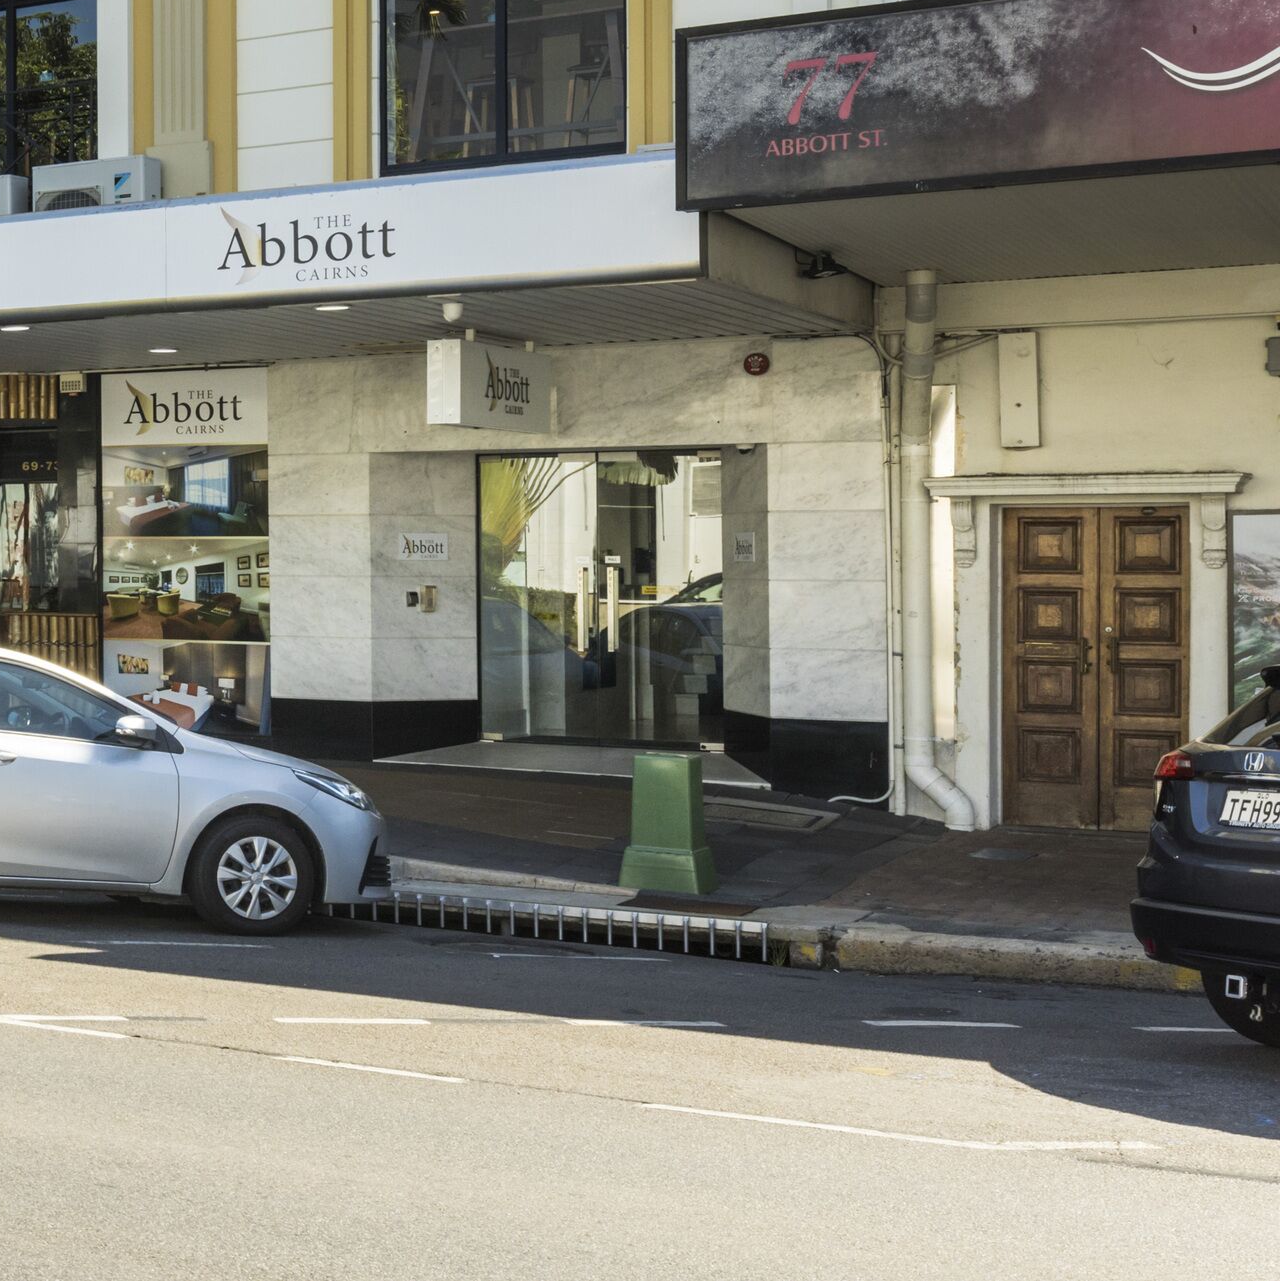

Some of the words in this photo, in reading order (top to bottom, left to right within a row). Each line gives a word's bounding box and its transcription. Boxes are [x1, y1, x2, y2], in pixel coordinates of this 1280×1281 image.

[783, 51, 878, 125] 77
[765, 133, 851, 157] ABBOTT
[858, 129, 888, 148] ST.
[313, 214, 352, 229] THE
[217, 219, 396, 270] Abbott
[295, 265, 369, 282] CAIRNS
[188, 390, 214, 400] THE
[485, 366, 530, 404] Abbott
[123, 392, 242, 424] Abbott
[175, 424, 224, 435] CAIRNS
[402, 539, 444, 554] Abbott
